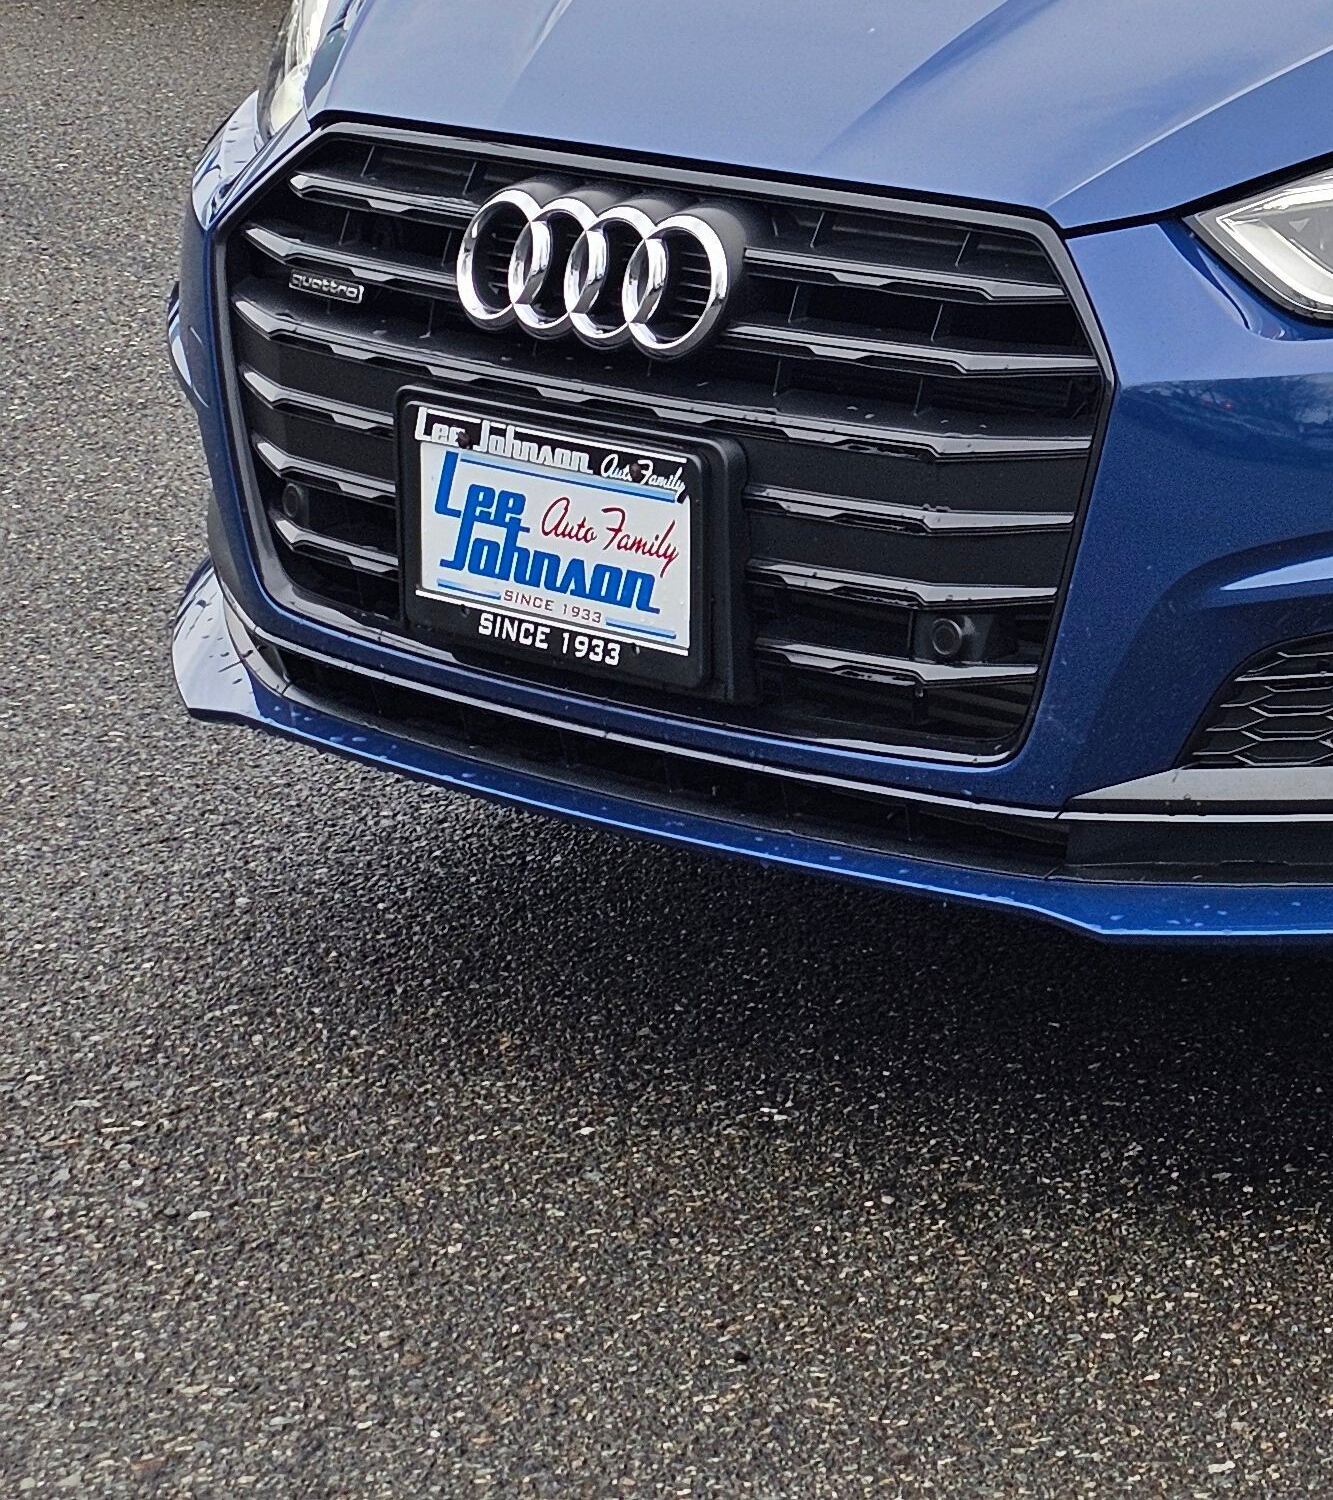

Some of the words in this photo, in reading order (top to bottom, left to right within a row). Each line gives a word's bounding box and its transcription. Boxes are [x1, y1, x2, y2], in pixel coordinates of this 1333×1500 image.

[292, 273, 358, 298] quattro
[434, 451, 530, 534] Lee
[473, 420, 594, 475] Johnson
[637, 459, 687, 501] Family
[440, 518, 661, 615] Johnson
[541, 496, 598, 545] Auto
[601, 506, 679, 579] Family
[478, 613, 552, 650] SINCE
[562, 631, 620, 666] 1933
[503, 589, 555, 612] SINCE
[563, 602, 603, 625] 1933
